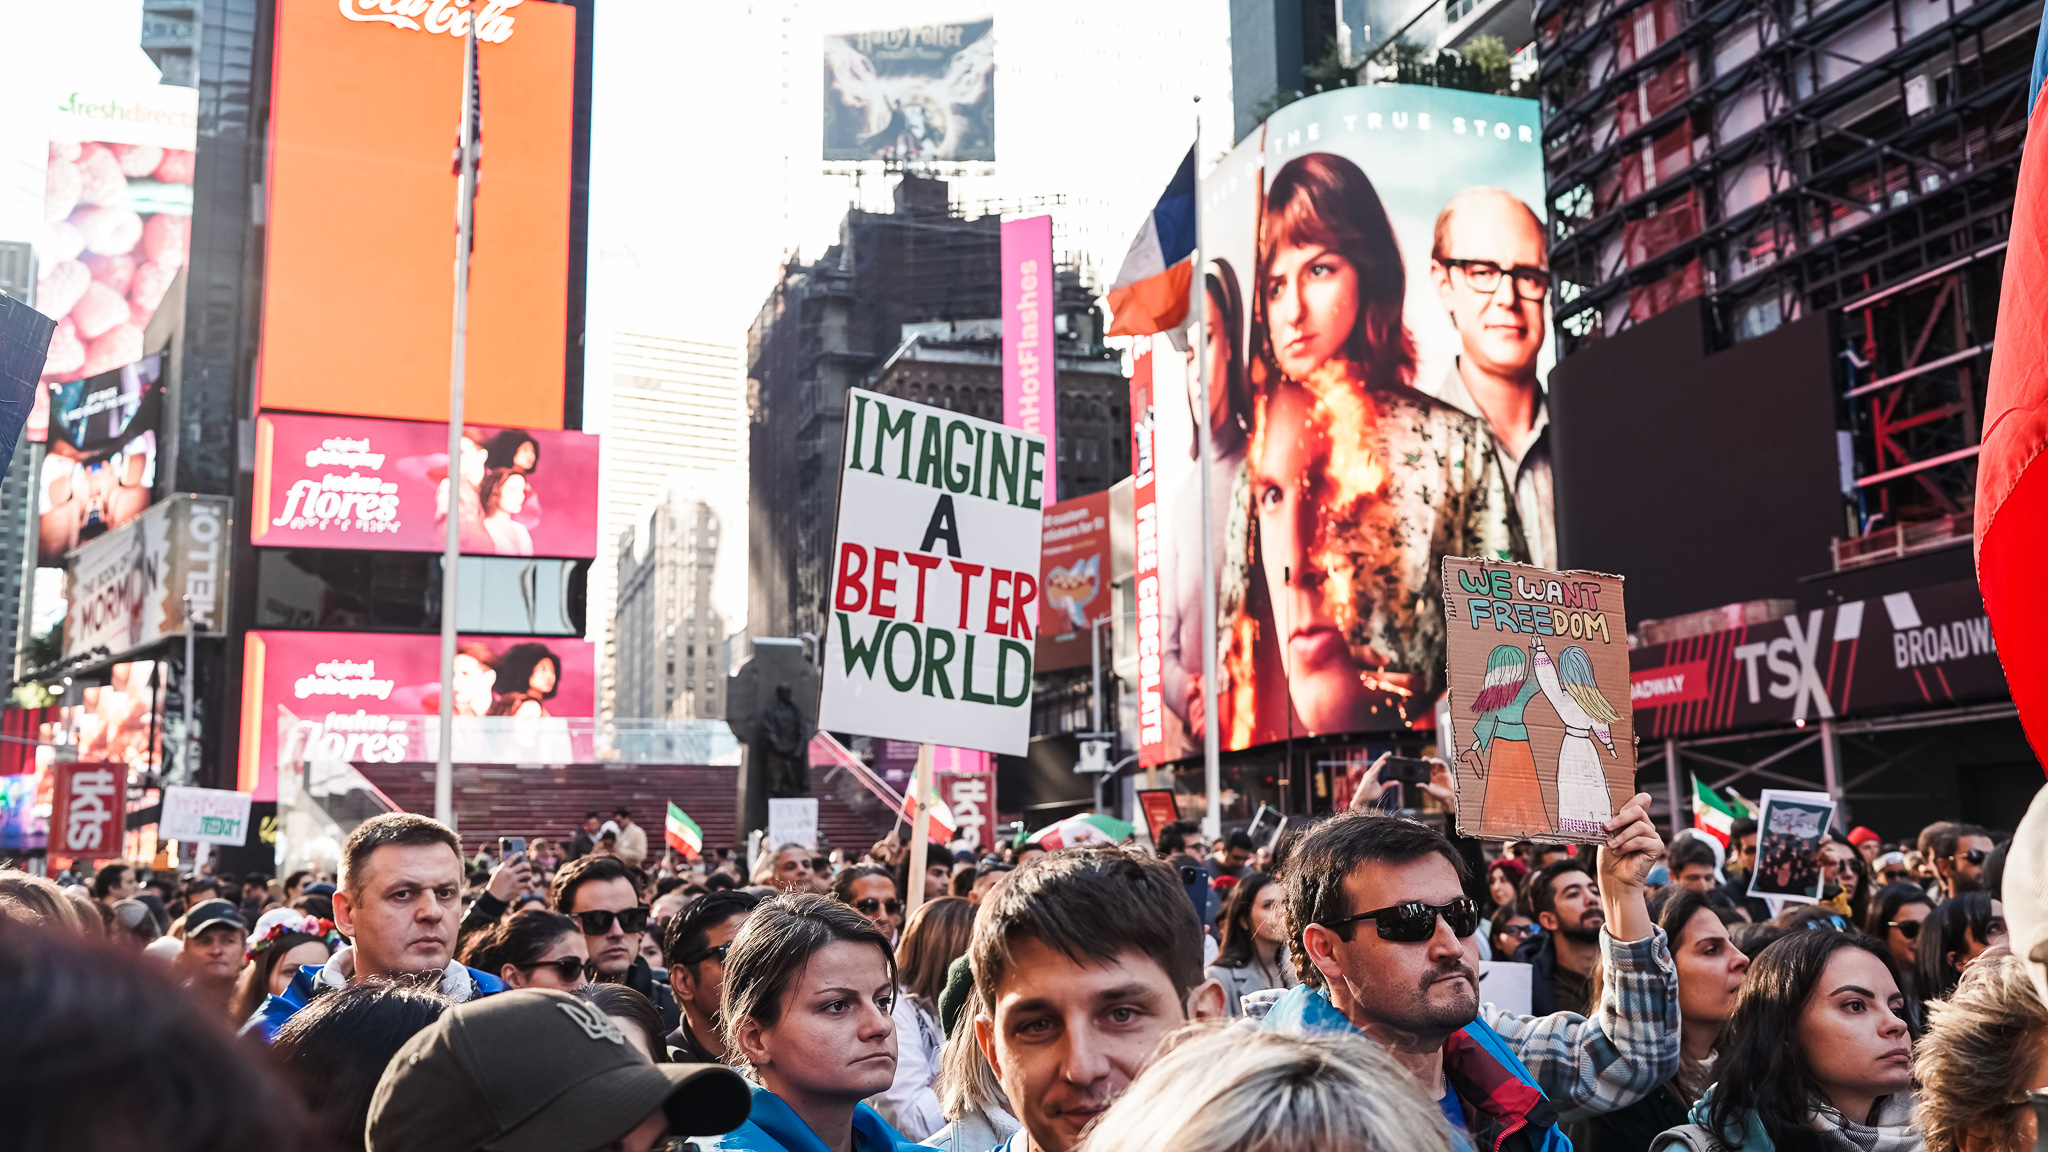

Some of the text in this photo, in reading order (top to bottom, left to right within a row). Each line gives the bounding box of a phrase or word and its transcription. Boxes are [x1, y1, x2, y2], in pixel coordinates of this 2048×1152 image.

[1273, 121, 1321, 156] THE
[1344, 111, 1432, 132] TRUE
[1452, 116, 1534, 143] STOR
[848, 394, 1046, 511] IMAGINE
[272, 479, 400, 526] flores
[919, 493, 962, 559] A
[187, 504, 220, 630] HELLO!
[835, 541, 1039, 642] BETTER
[1458, 567, 1602, 611] WE WANT
[835, 610, 1033, 708] WORLD
[1138, 575, 1163, 746] CHOCOLATE
[1468, 598, 1611, 644] FREEDOM
[1893, 615, 1997, 670] BROADW
[1734, 609, 1835, 721] TSX
[67, 768, 116, 851] tkts
